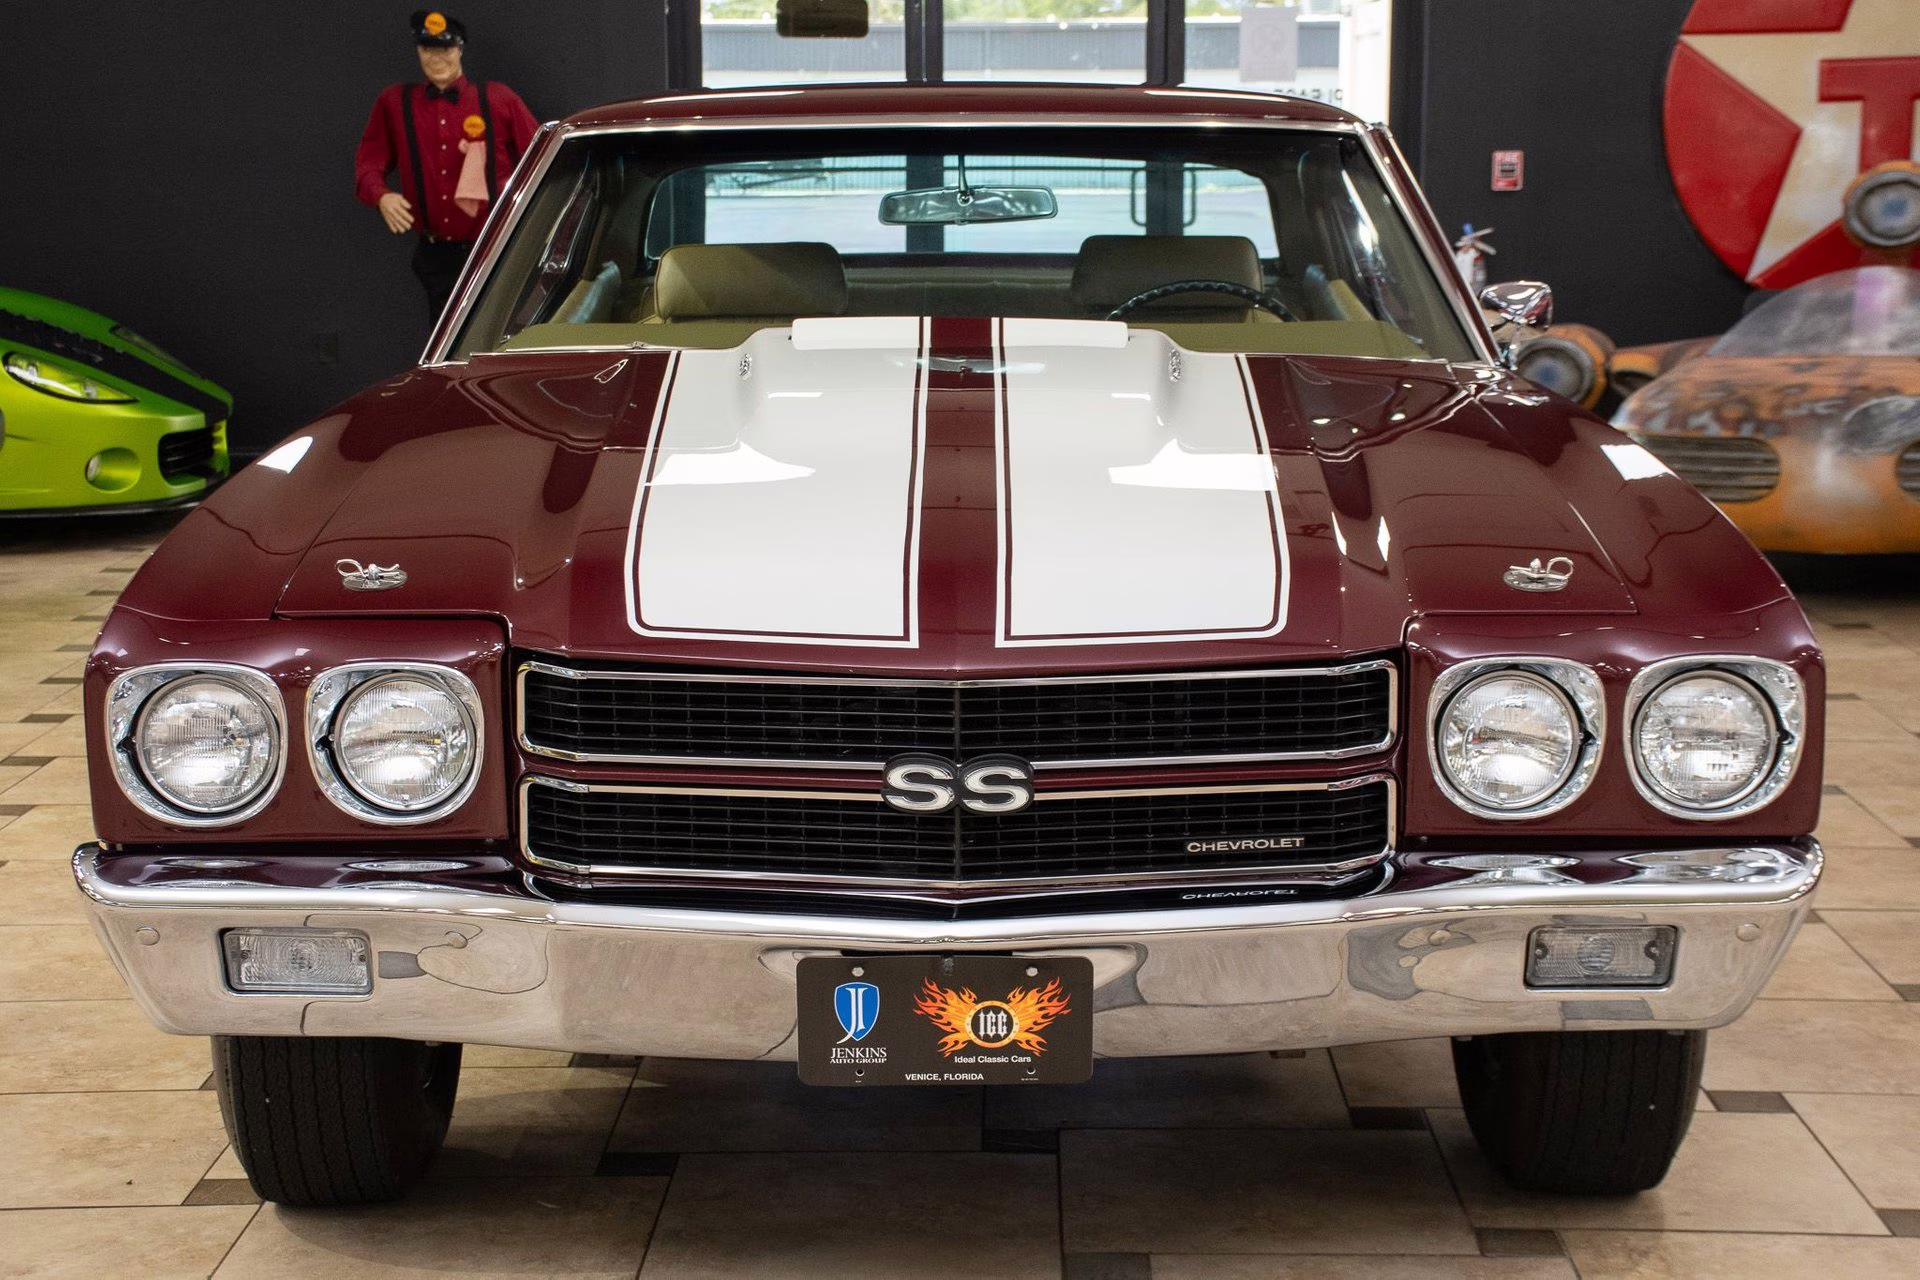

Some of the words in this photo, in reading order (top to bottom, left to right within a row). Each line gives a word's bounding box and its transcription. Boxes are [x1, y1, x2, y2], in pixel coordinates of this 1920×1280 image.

[885, 763, 1030, 813] SS
[1187, 837, 1305, 853] CHEVROLET
[830, 1047, 887, 1059] JENKINS
[954, 1055, 976, 1063] Ideal
[977, 1055, 1009, 1064] Classic
[1010, 1055, 1032, 1063] Cars
[904, 1073, 942, 1081] VENICE,
[944, 1073, 984, 1081] FLORIDA
